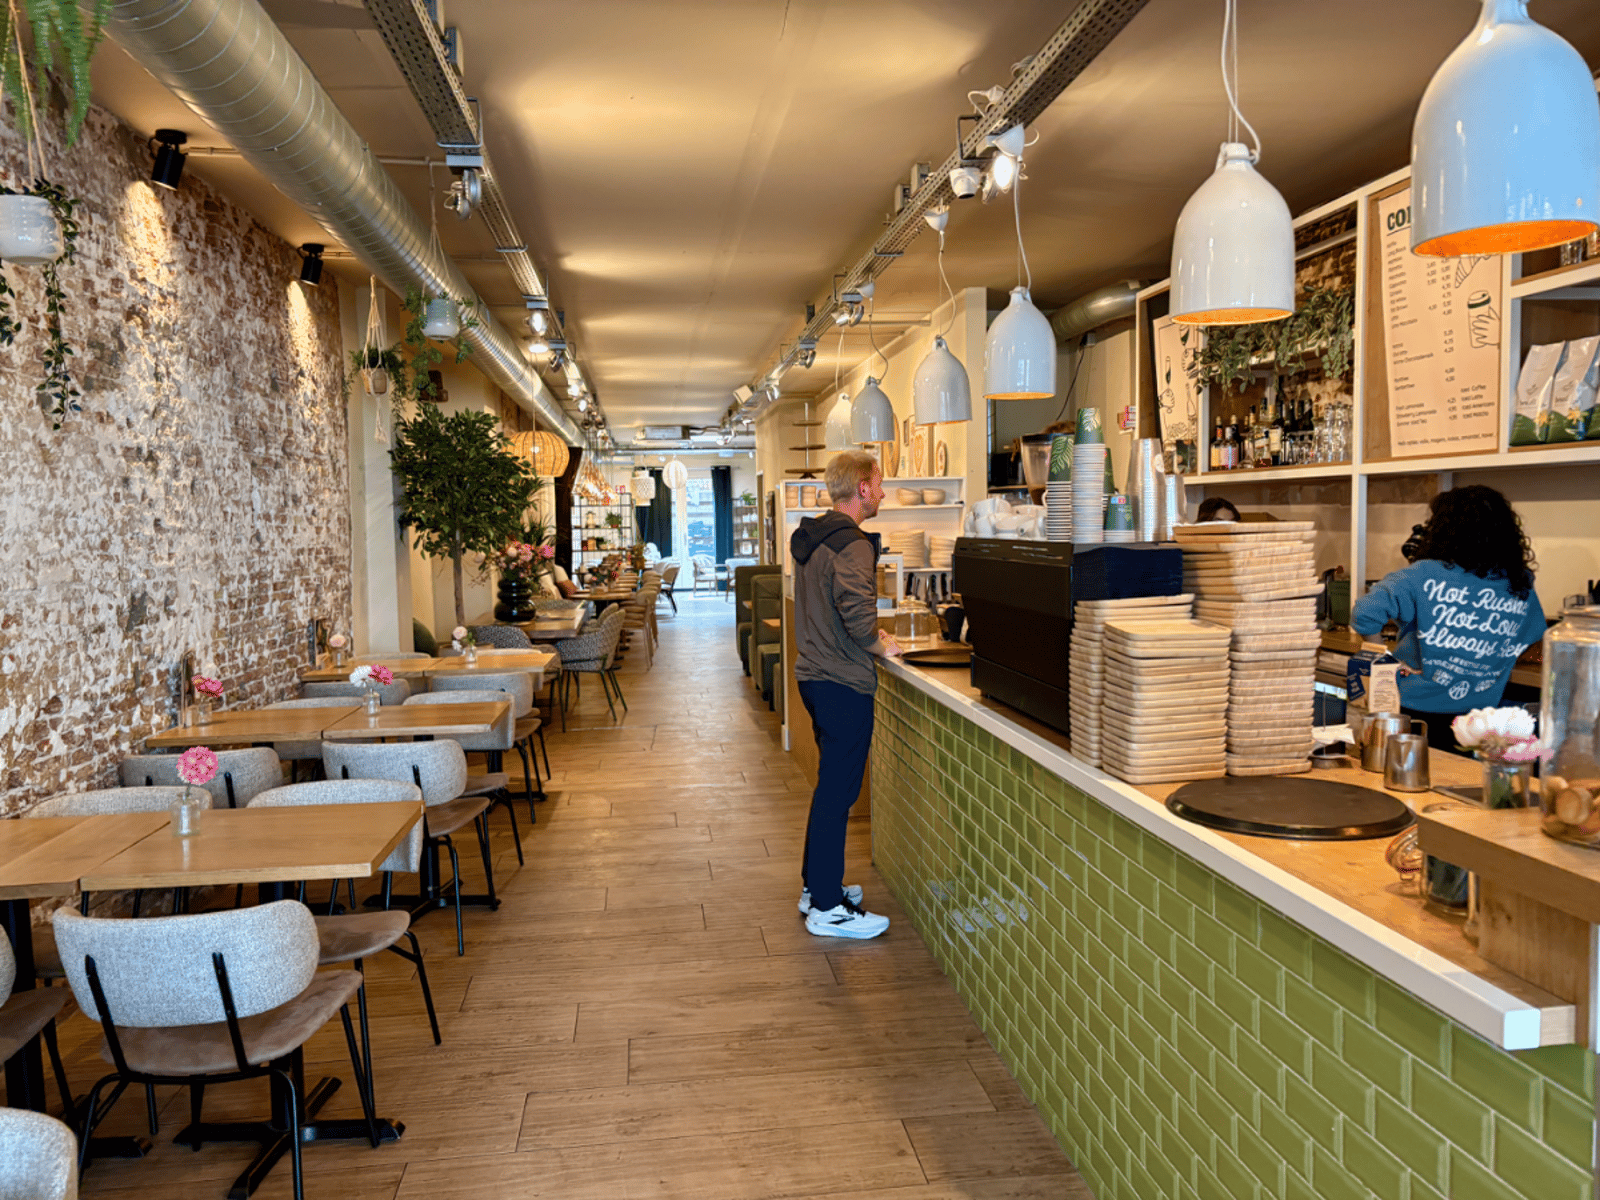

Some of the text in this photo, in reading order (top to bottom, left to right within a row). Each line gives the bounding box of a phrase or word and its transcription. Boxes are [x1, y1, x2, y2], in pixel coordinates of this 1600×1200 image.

[1423, 579, 1470, 605] Not
[1432, 604, 1479, 630] Not
[1417, 624, 1498, 659] Always
